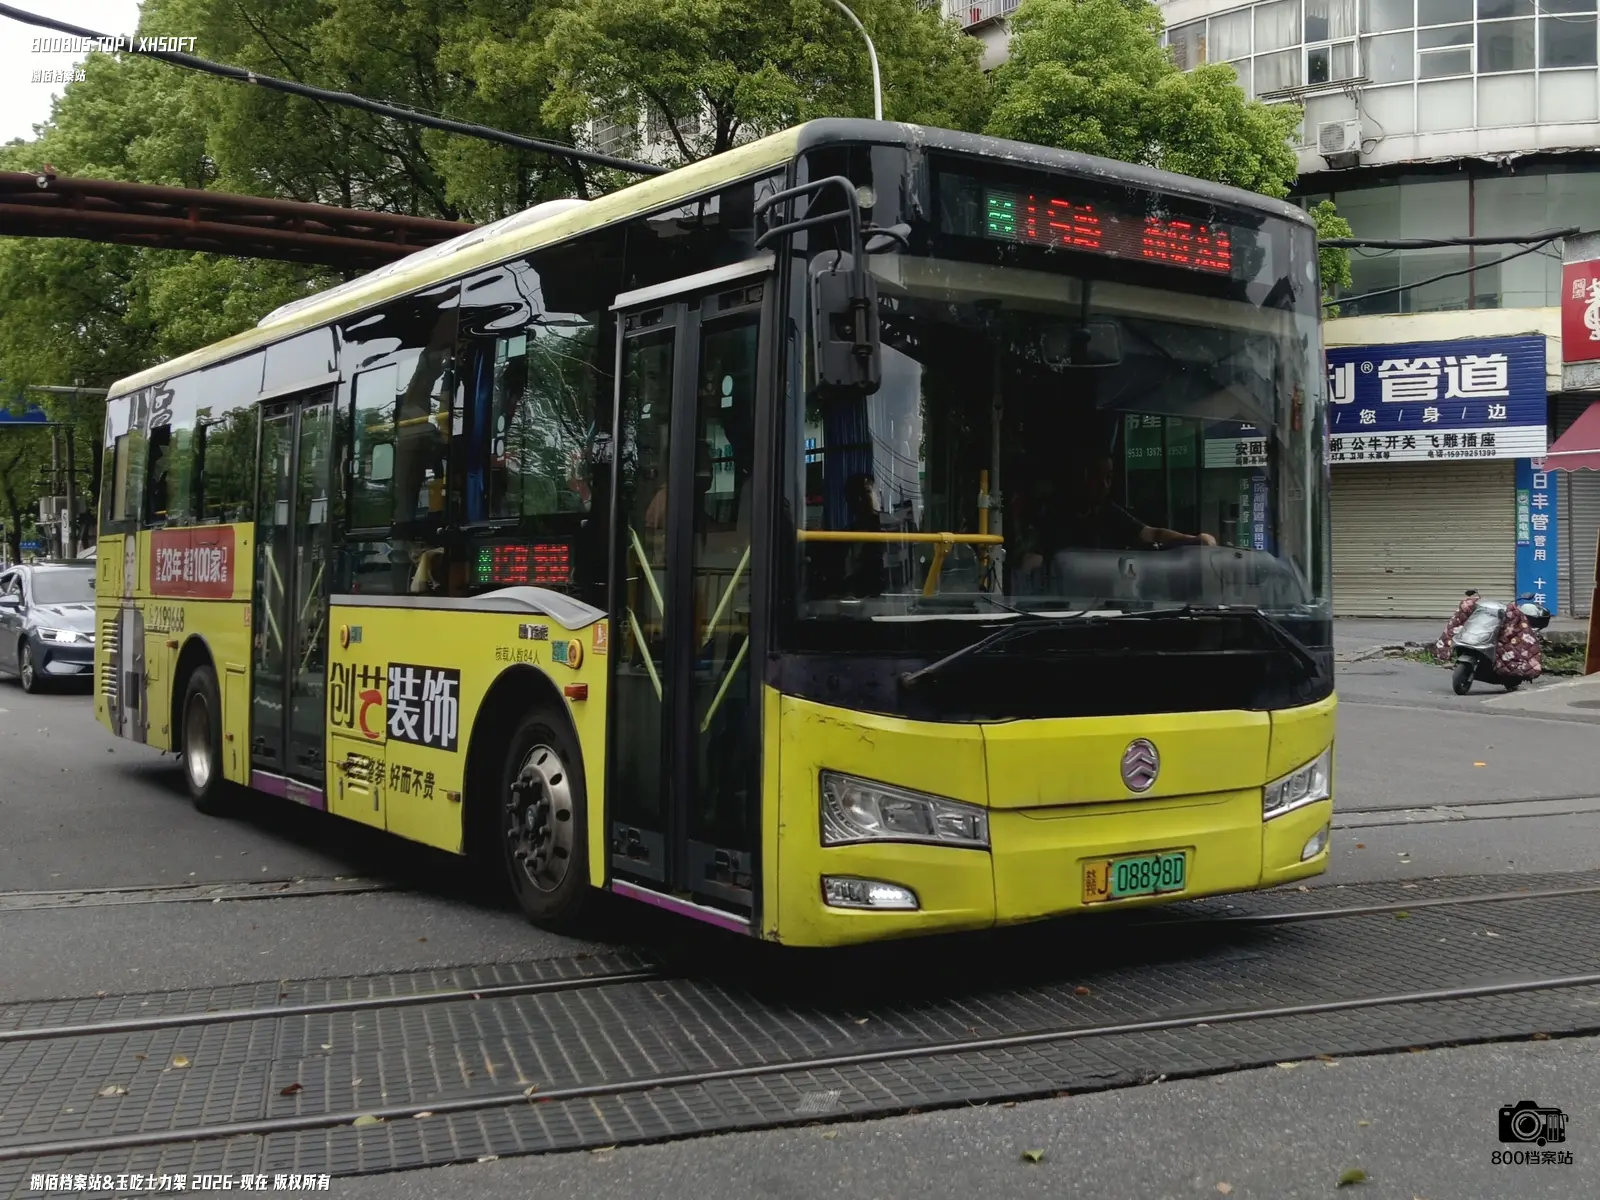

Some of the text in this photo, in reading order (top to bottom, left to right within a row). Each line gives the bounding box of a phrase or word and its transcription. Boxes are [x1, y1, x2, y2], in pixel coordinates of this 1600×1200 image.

[1352, 435, 1416, 450] 公牛开关
[1425, 432, 1496, 448] 飞雕插座
[389, 763, 435, 801] 好而不贵
